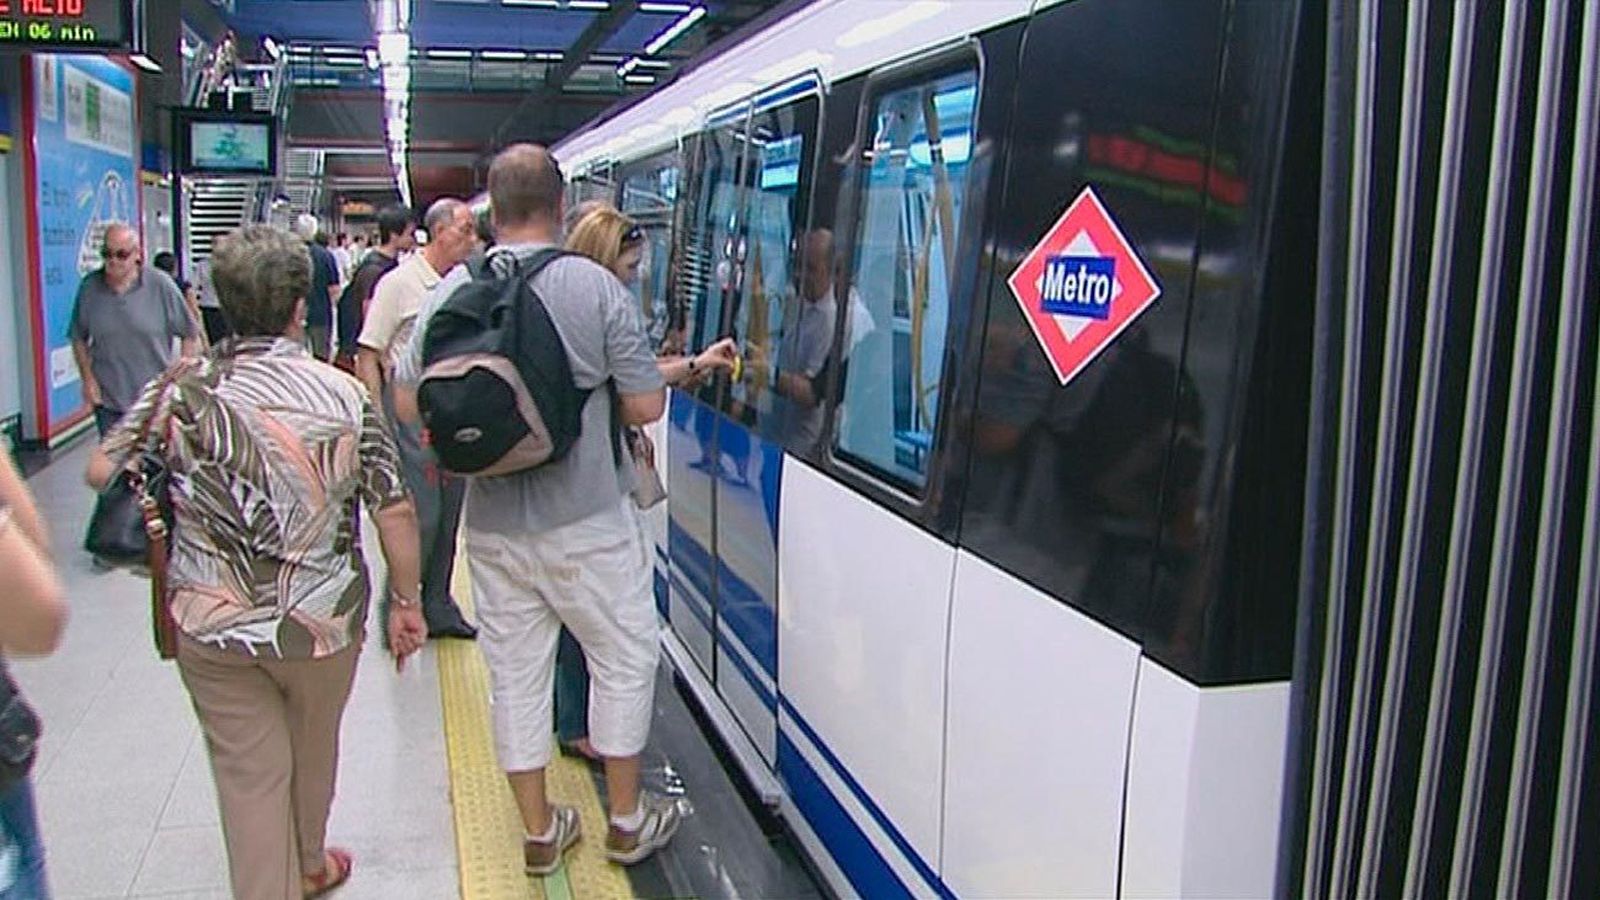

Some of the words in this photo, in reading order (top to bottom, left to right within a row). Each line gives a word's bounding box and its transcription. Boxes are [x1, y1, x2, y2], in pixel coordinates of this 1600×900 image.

[28, 22, 52, 40] 06
[60, 25, 95, 42] min
[1044, 263, 1110, 305] Metro
